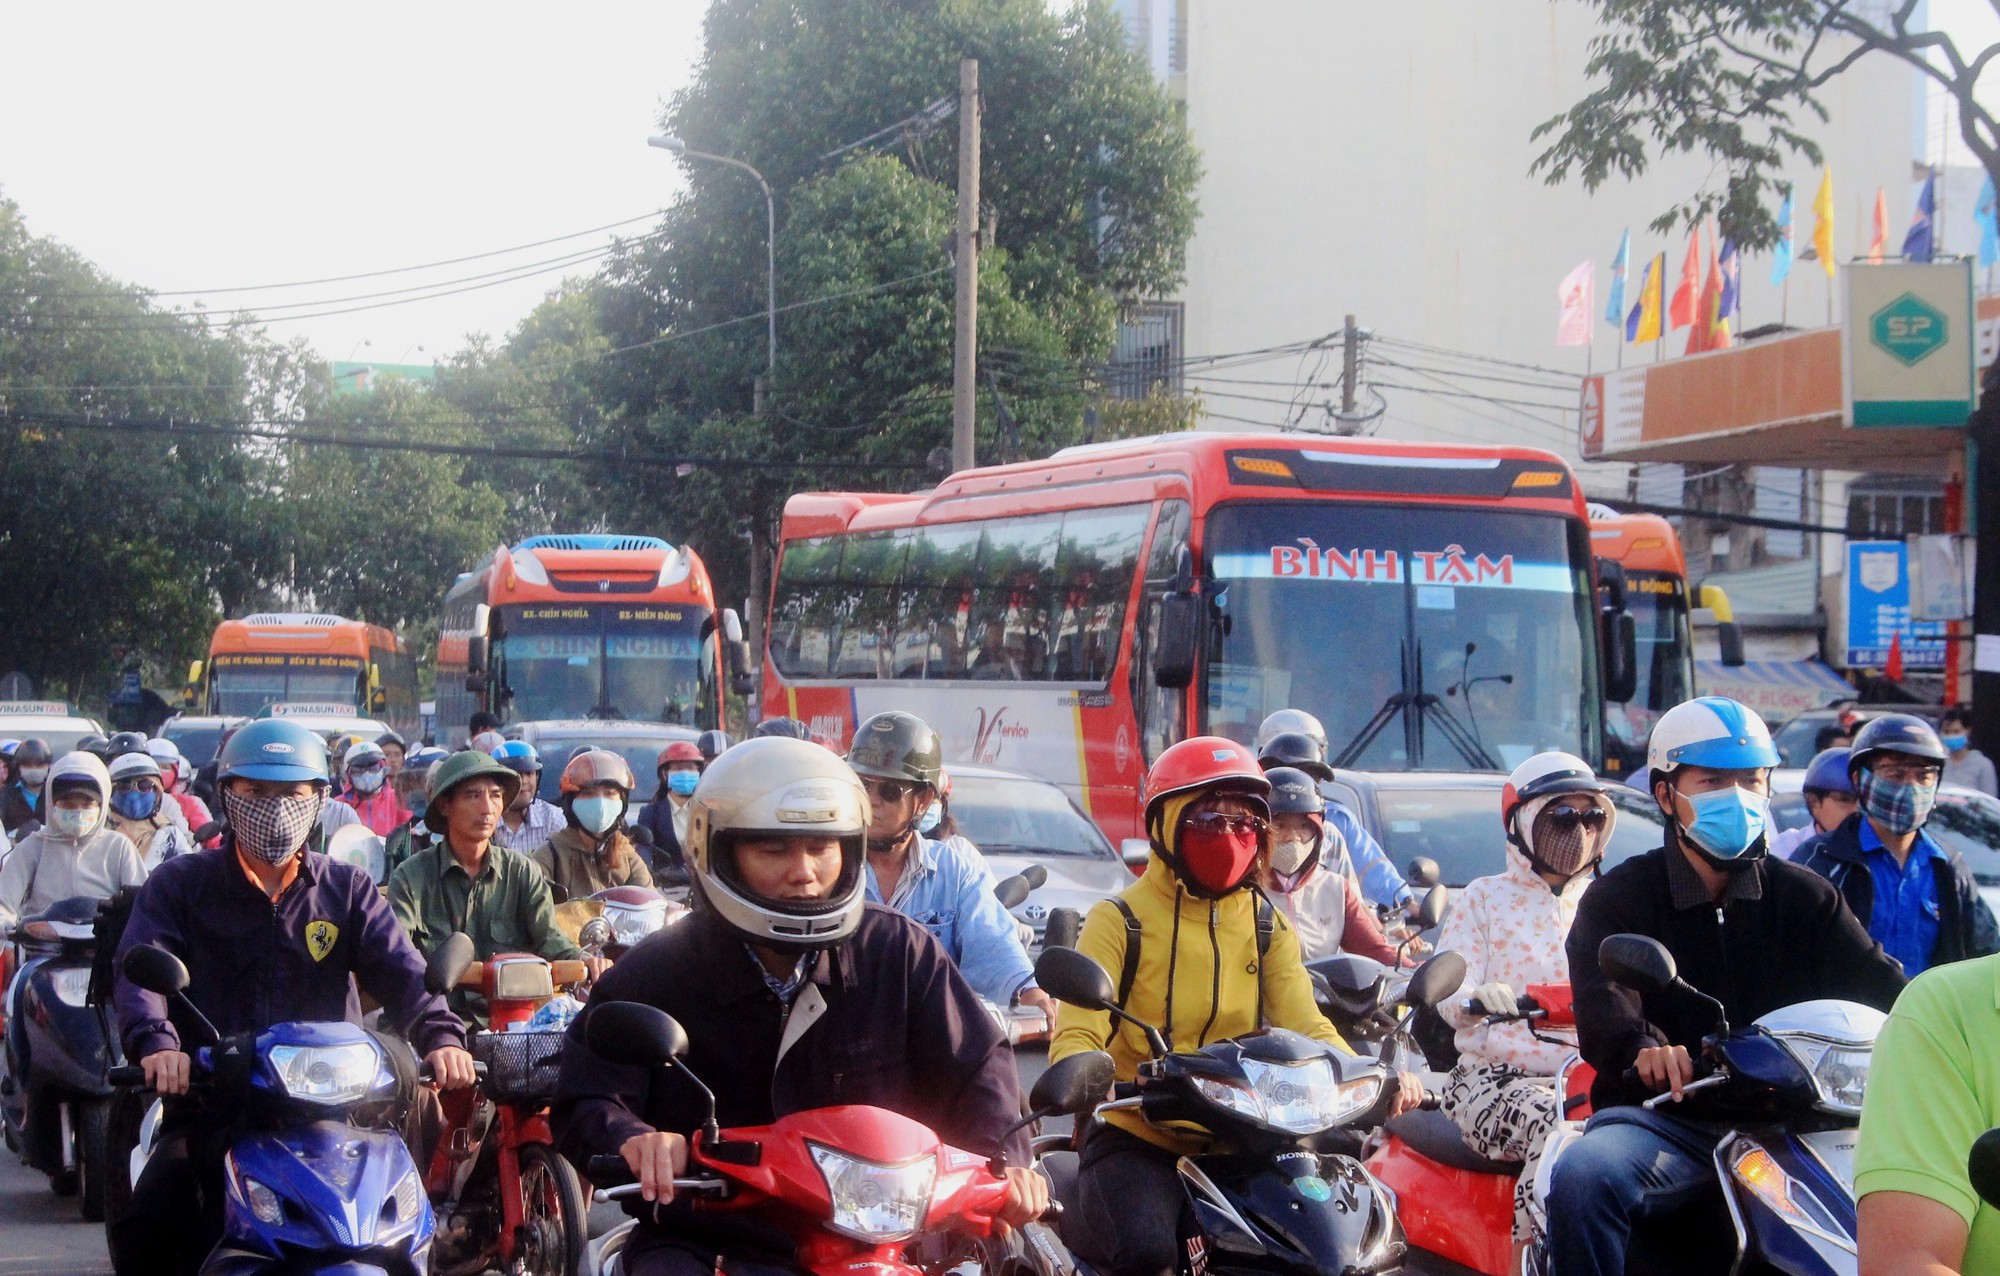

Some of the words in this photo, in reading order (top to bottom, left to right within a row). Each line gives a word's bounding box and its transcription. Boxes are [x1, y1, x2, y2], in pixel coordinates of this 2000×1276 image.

[1888, 316, 1932, 336] SP
[1271, 537, 1397, 580] BÌNH
[1413, 544, 1513, 584] TÂM
